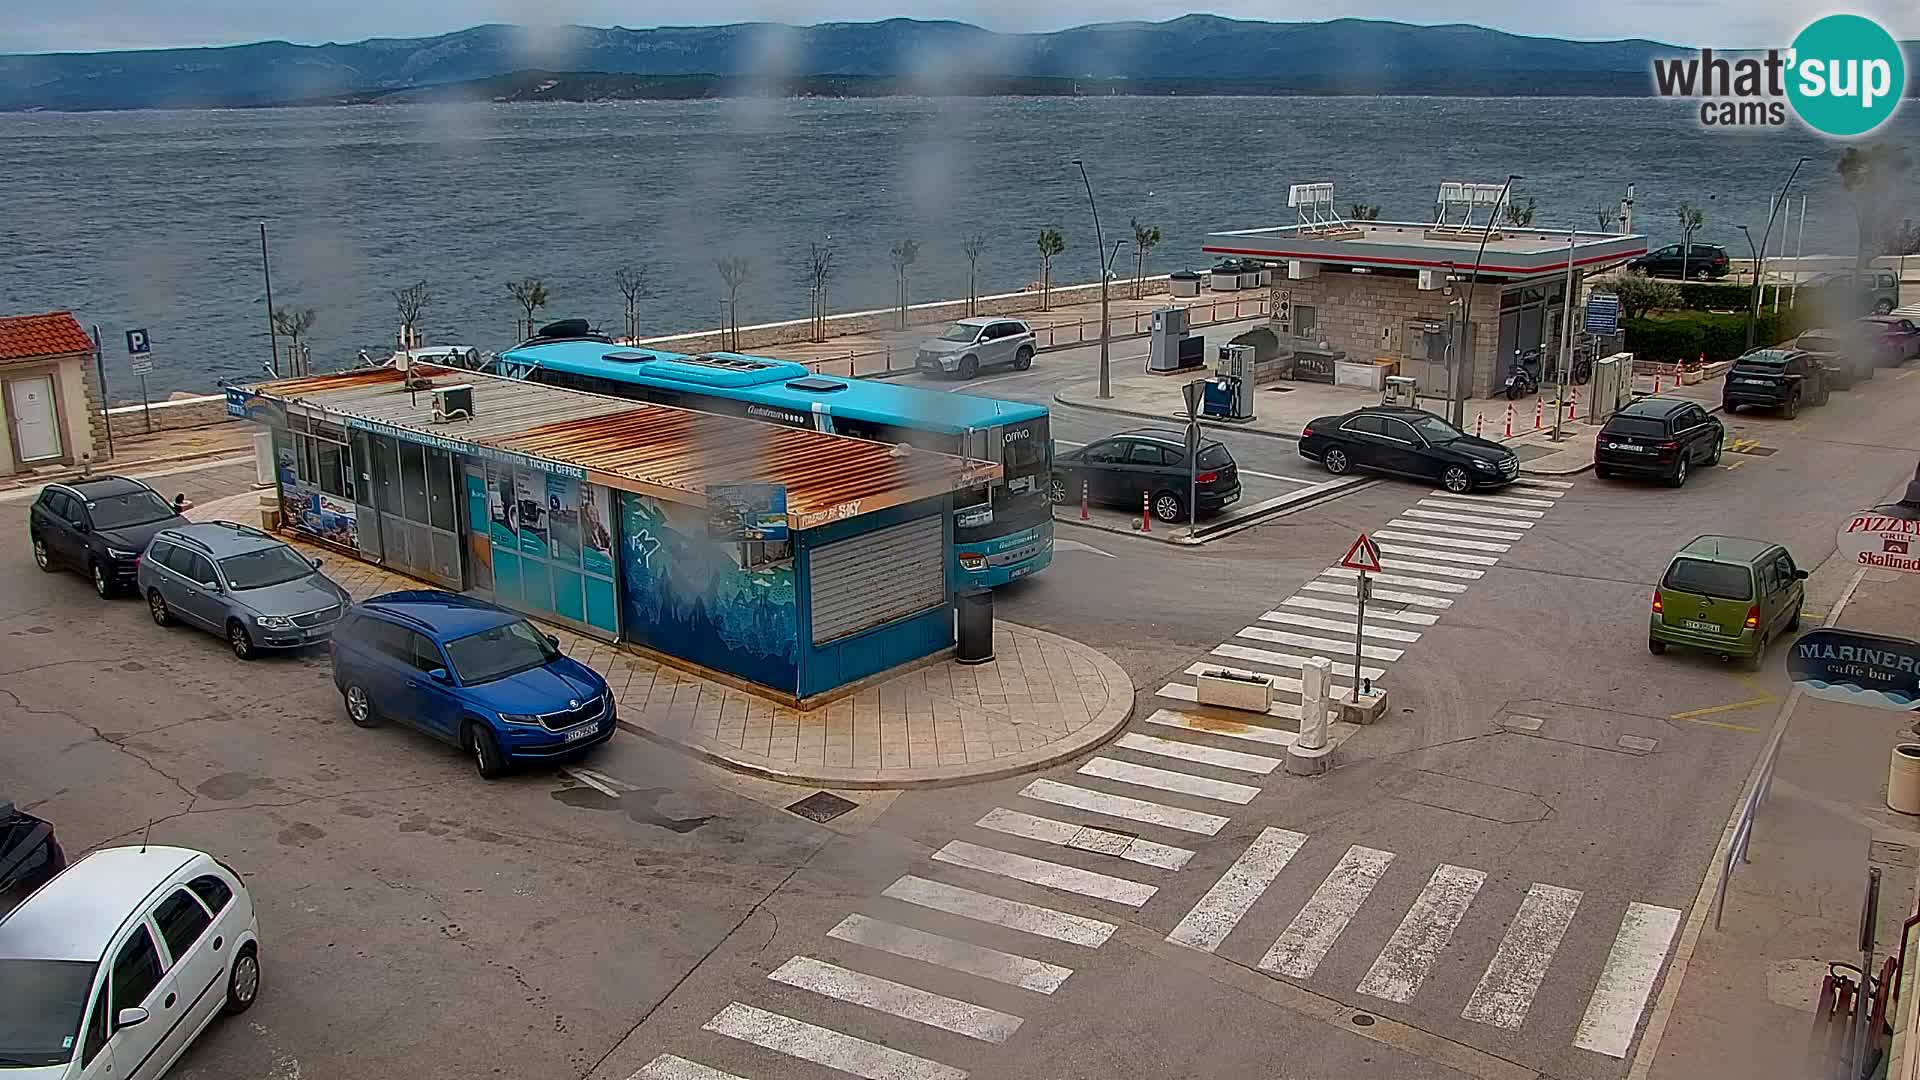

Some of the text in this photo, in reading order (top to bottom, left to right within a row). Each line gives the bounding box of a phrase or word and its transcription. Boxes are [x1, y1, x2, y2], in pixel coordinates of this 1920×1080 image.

[132, 332, 144, 350] P
[1005, 427, 1030, 443] arriva
[397, 428, 436, 446] AUTOBUSNA
[437, 437, 468, 453] POSTAJA
[495, 451, 527, 465] STATION
[529, 459, 554, 473] TICKET
[556, 464, 583, 478] OFFICE
[1880, 532, 1915, 543] GRILL
[1827, 664, 1896, 681] caffe bar
